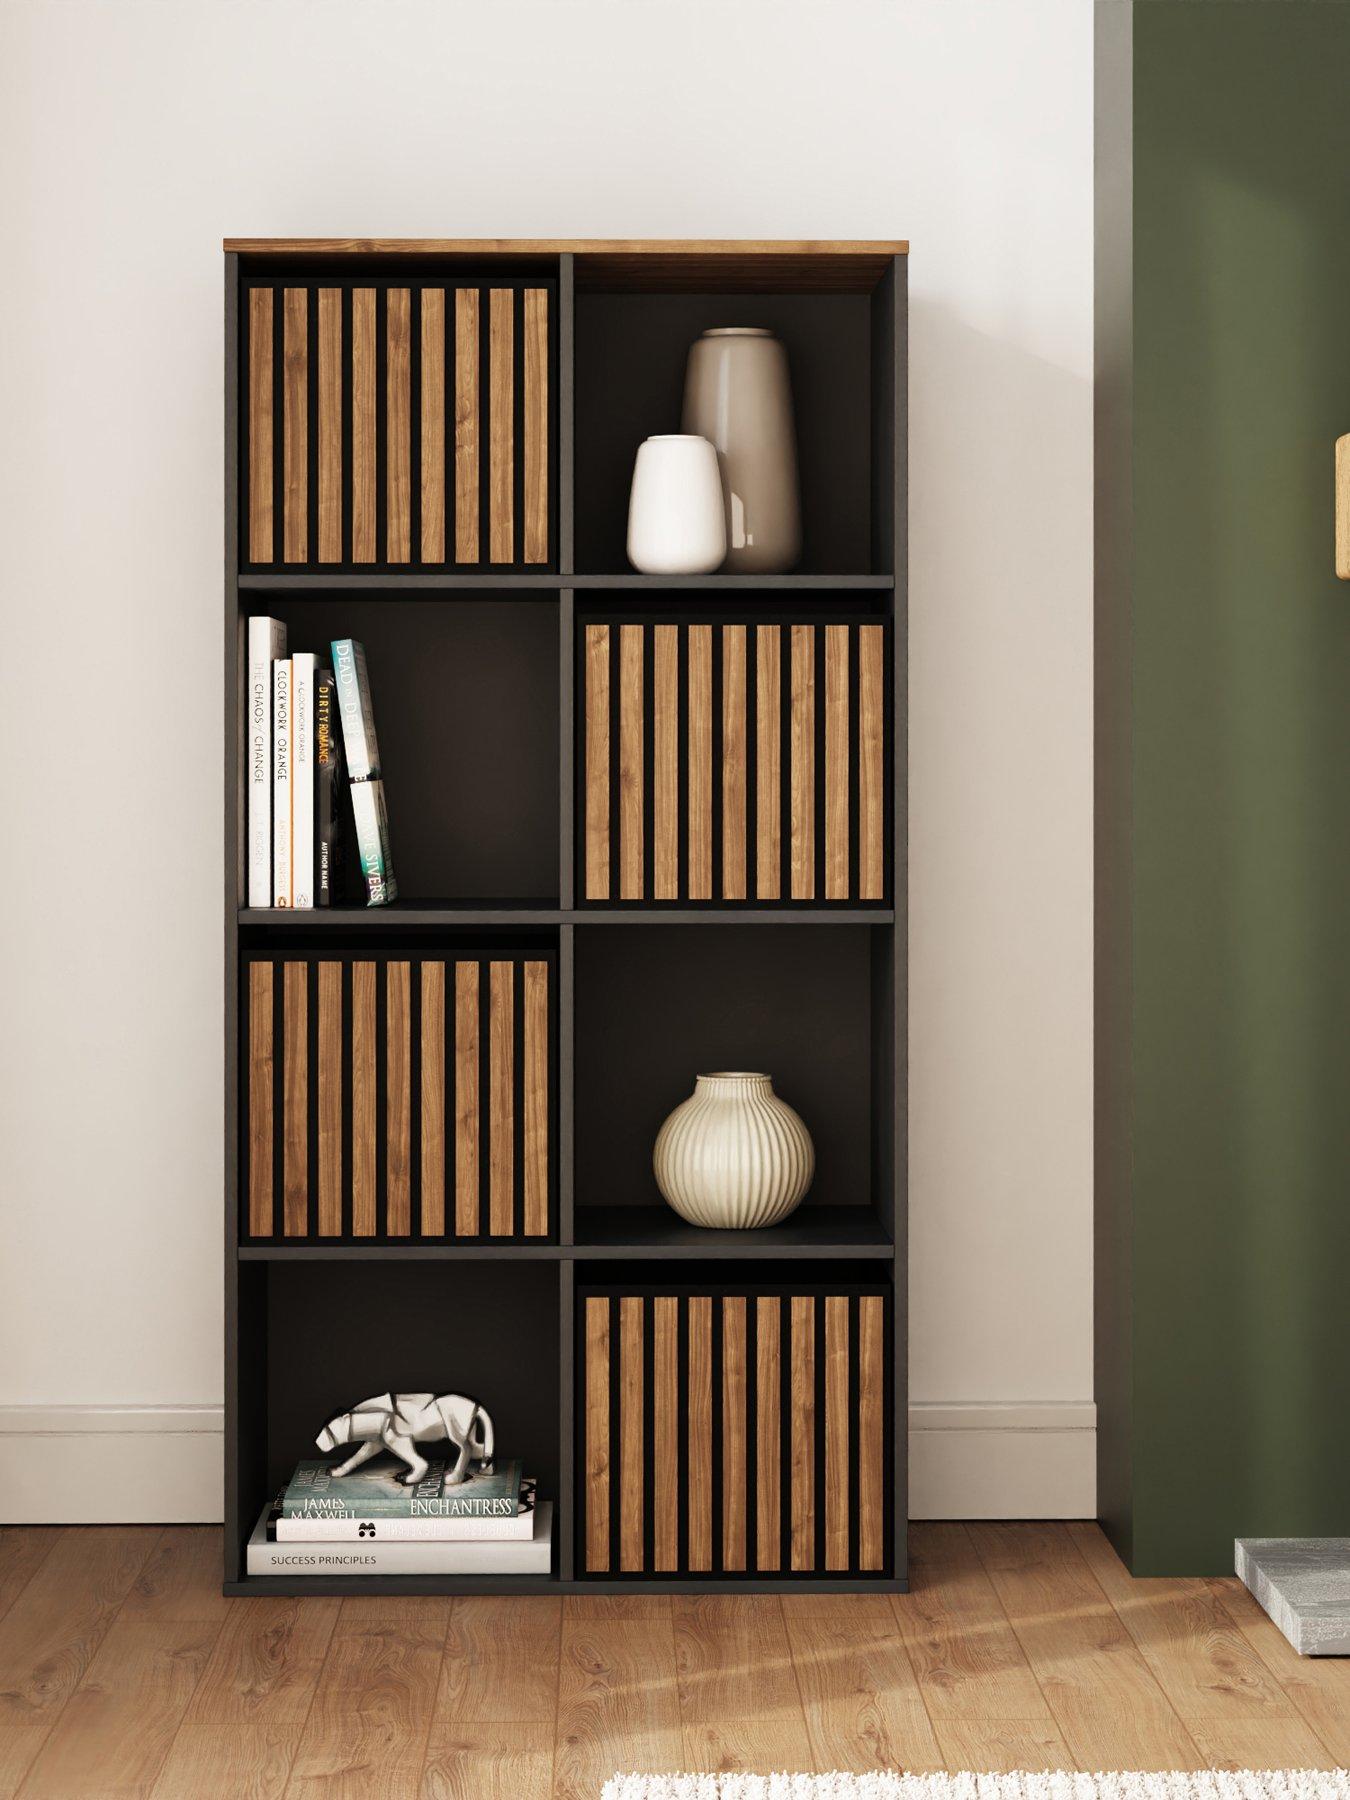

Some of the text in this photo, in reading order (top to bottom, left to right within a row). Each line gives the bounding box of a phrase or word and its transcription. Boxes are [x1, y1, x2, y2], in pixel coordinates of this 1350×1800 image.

[336, 644, 353, 683] DEAD
[254, 683, 265, 723] CHAOS
[344, 703, 360, 737] DEEP
[276, 671, 288, 781] CLOCKWORK ORANGE
[318, 687, 330, 764] DIRTY ROMANCE
[254, 736, 265, 785] CHANGE
[321, 842, 329, 890] AUTHOR NAME
[364, 854, 385, 902] SIVERS
[303, 1498, 346, 1512] JAMES
[410, 1498, 512, 1516] ENCHANTRESS
[270, 1556, 377, 1565] SUCCESS PRINCIPLES
